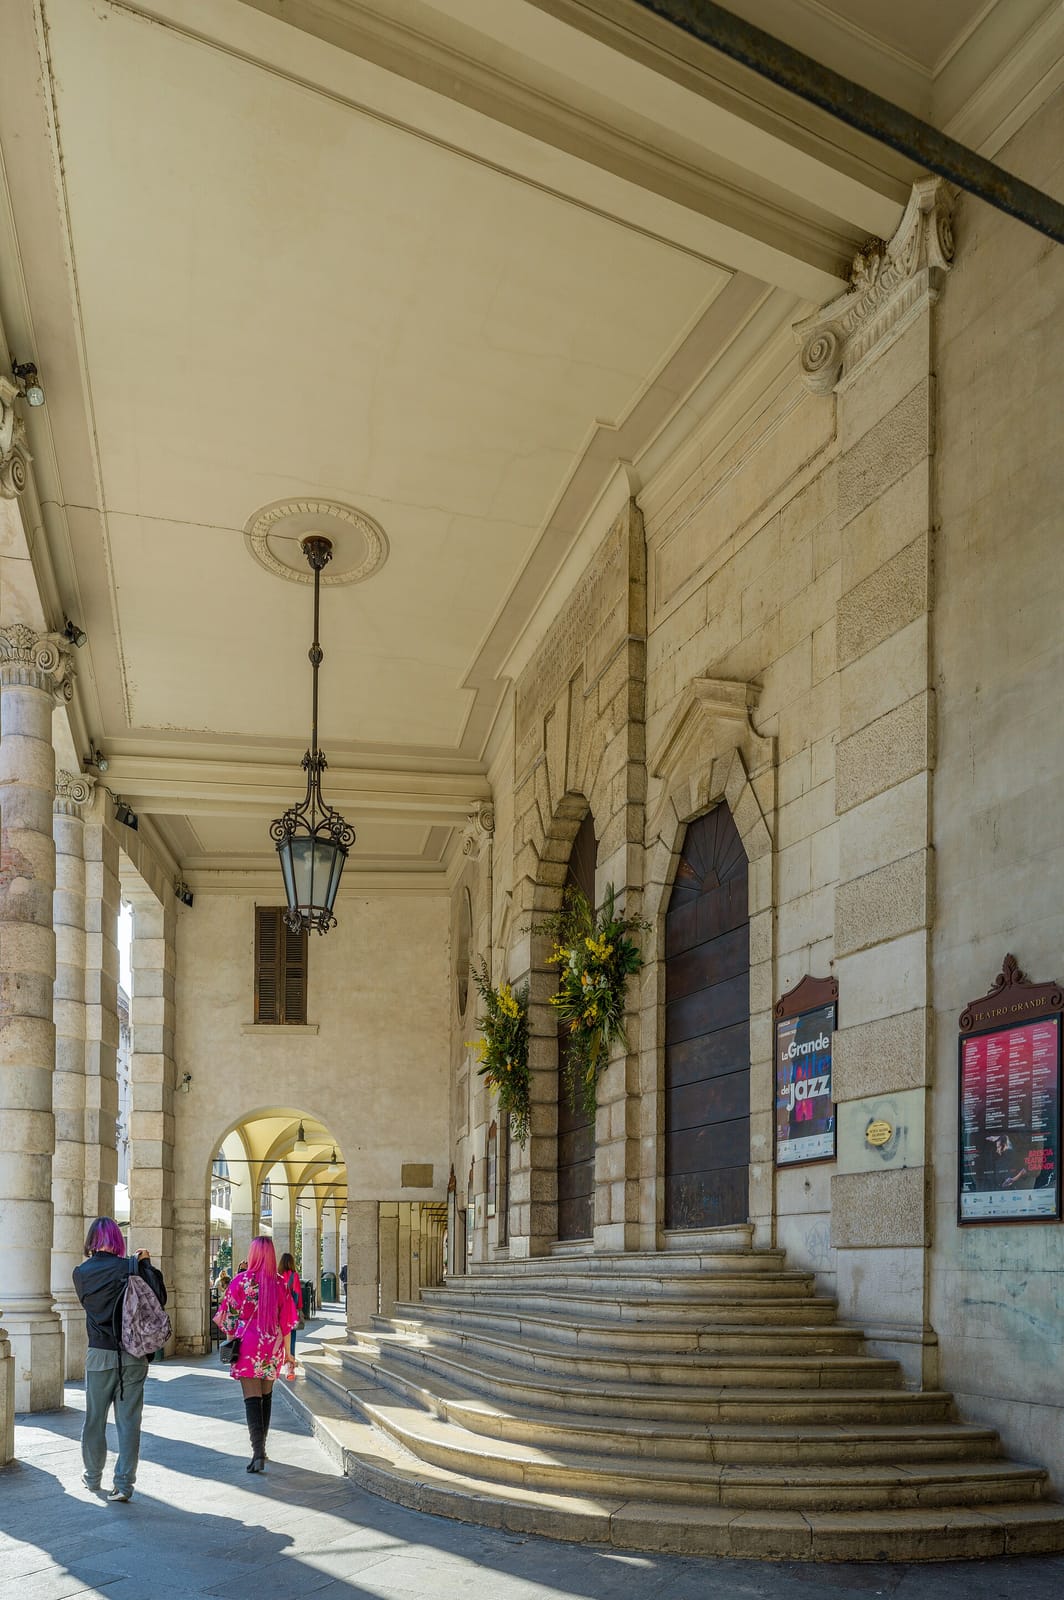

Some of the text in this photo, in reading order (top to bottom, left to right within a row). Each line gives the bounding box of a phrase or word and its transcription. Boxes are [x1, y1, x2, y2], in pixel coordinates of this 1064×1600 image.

[975, 997, 1047, 1020] TEATRO GRANDE
[788, 1032, 830, 1058] Grande
[786, 1074, 830, 1112] jazz
